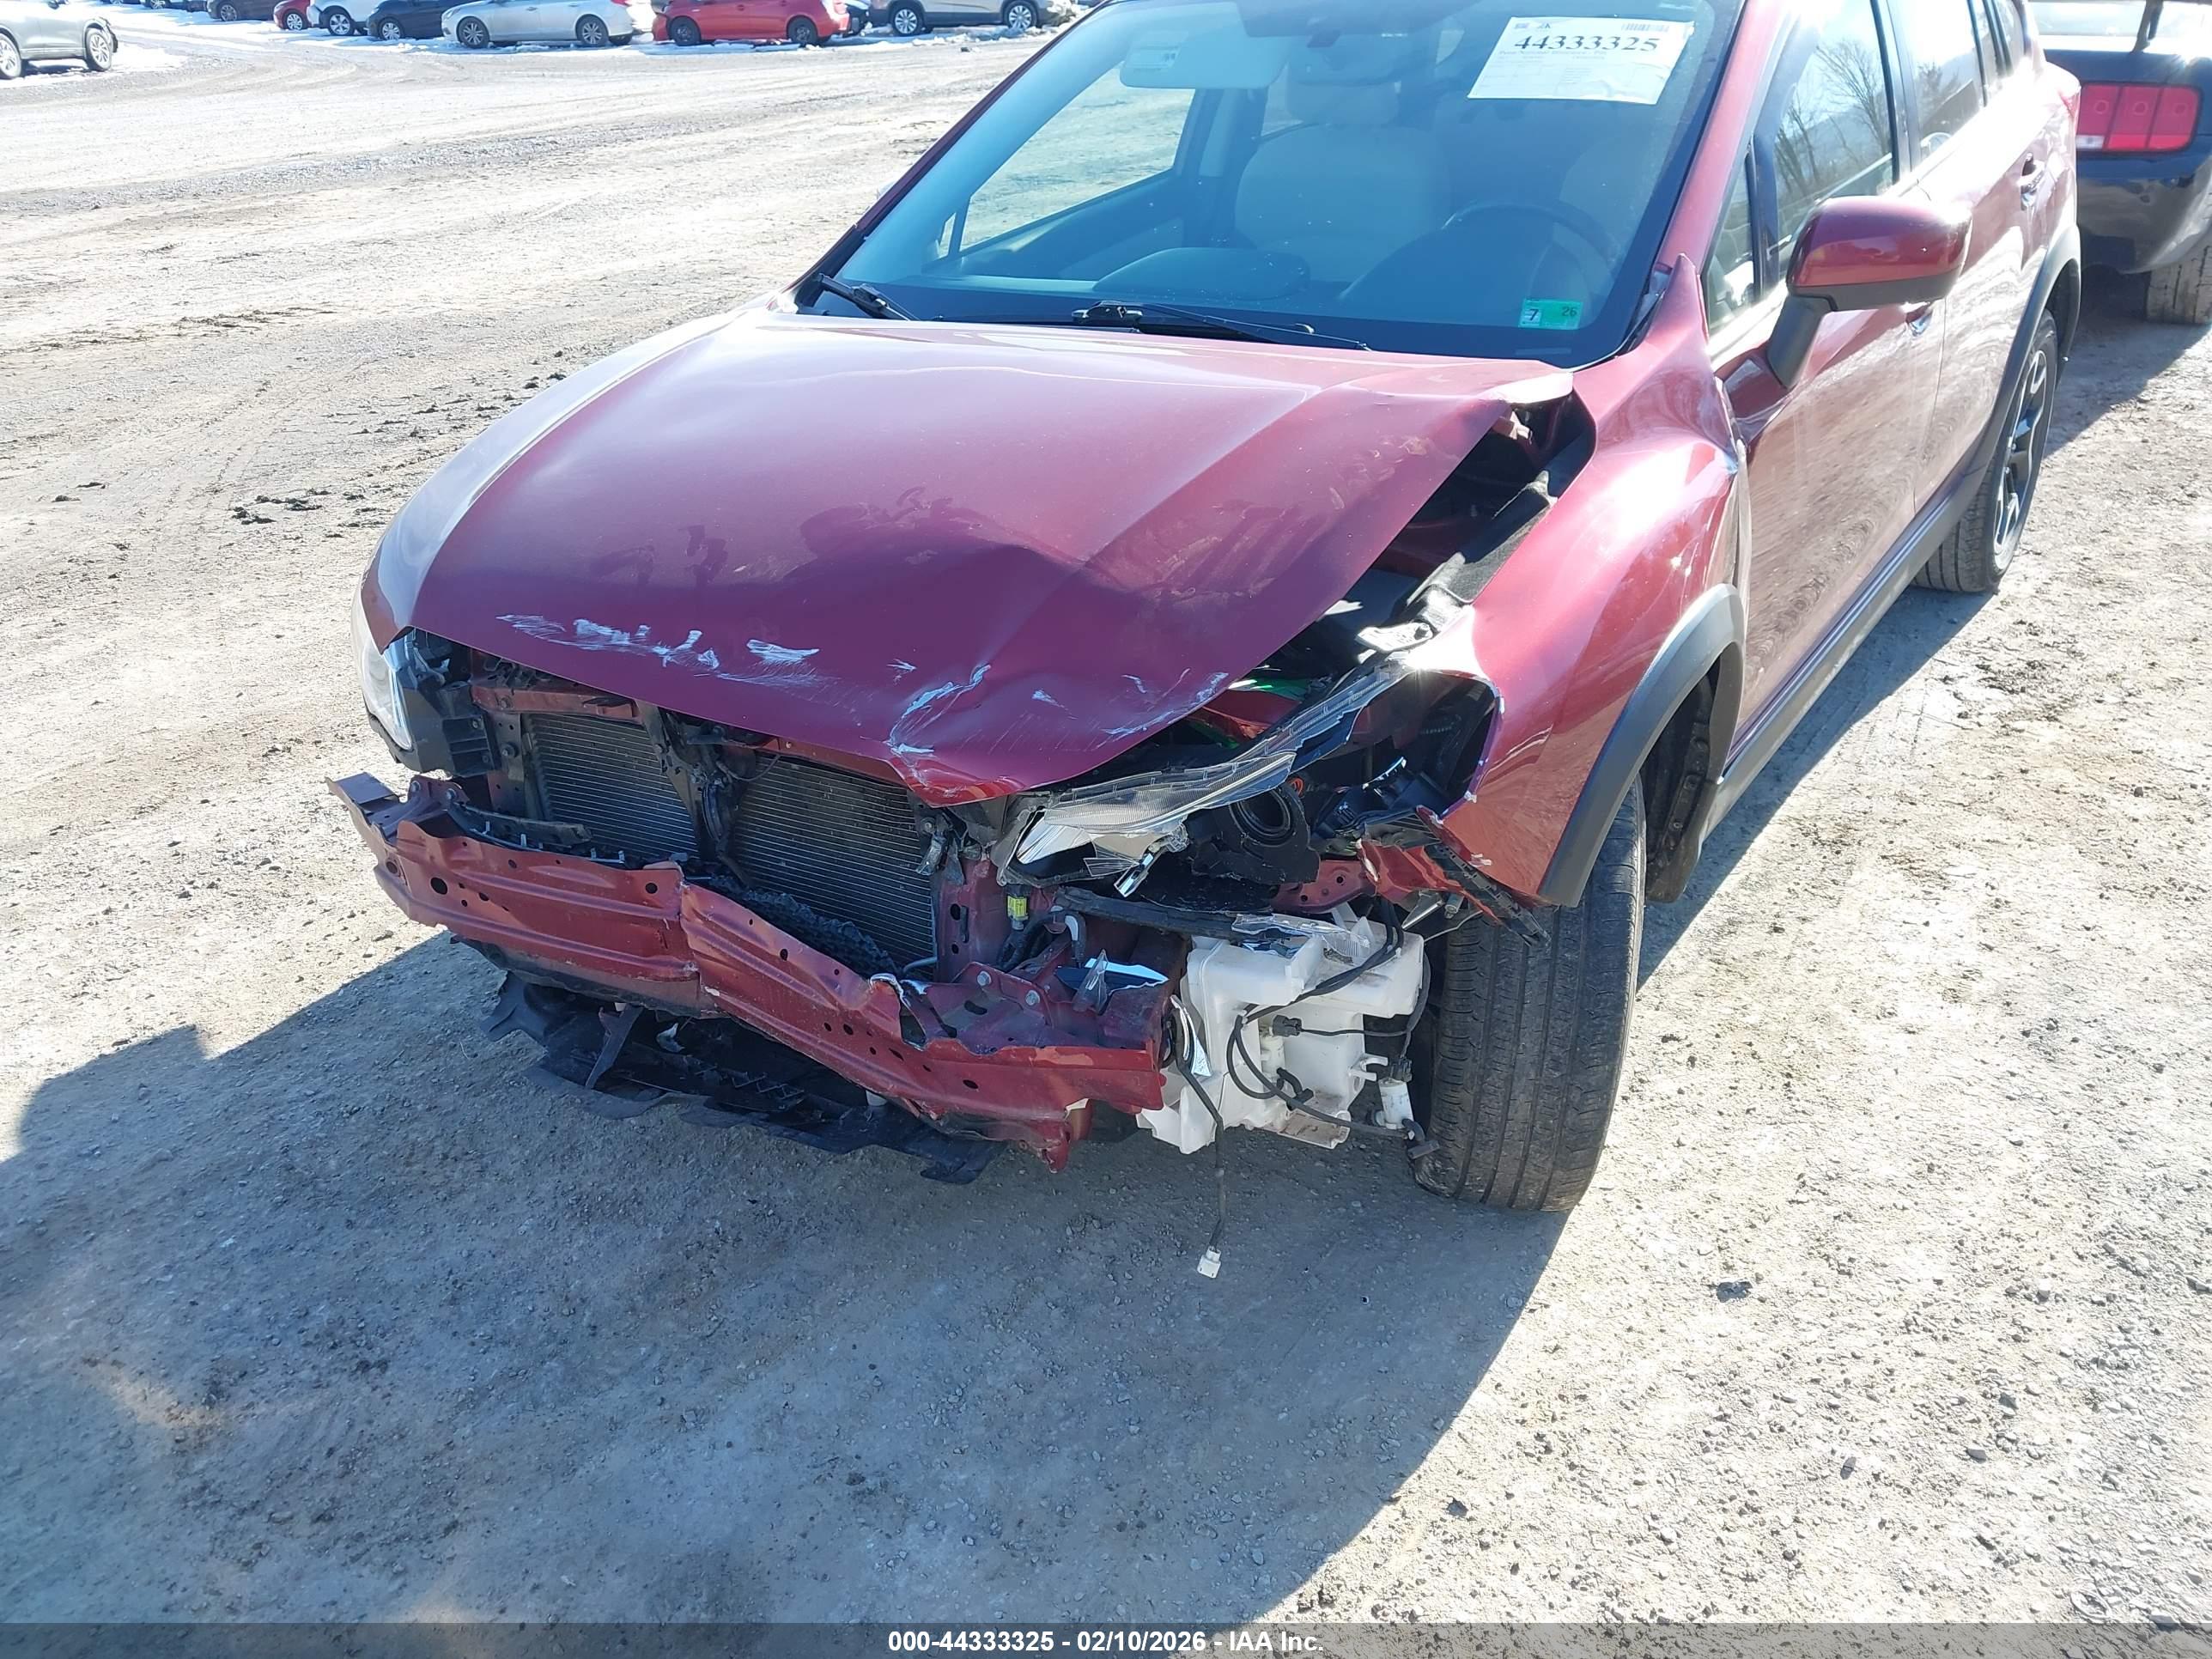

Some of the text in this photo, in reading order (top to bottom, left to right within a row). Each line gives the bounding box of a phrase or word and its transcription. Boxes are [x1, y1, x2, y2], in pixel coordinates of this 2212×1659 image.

[1514, 35, 1661, 52] 44333325
[1528, 308, 1540, 321] 7
[1562, 306, 1577, 317] 26
